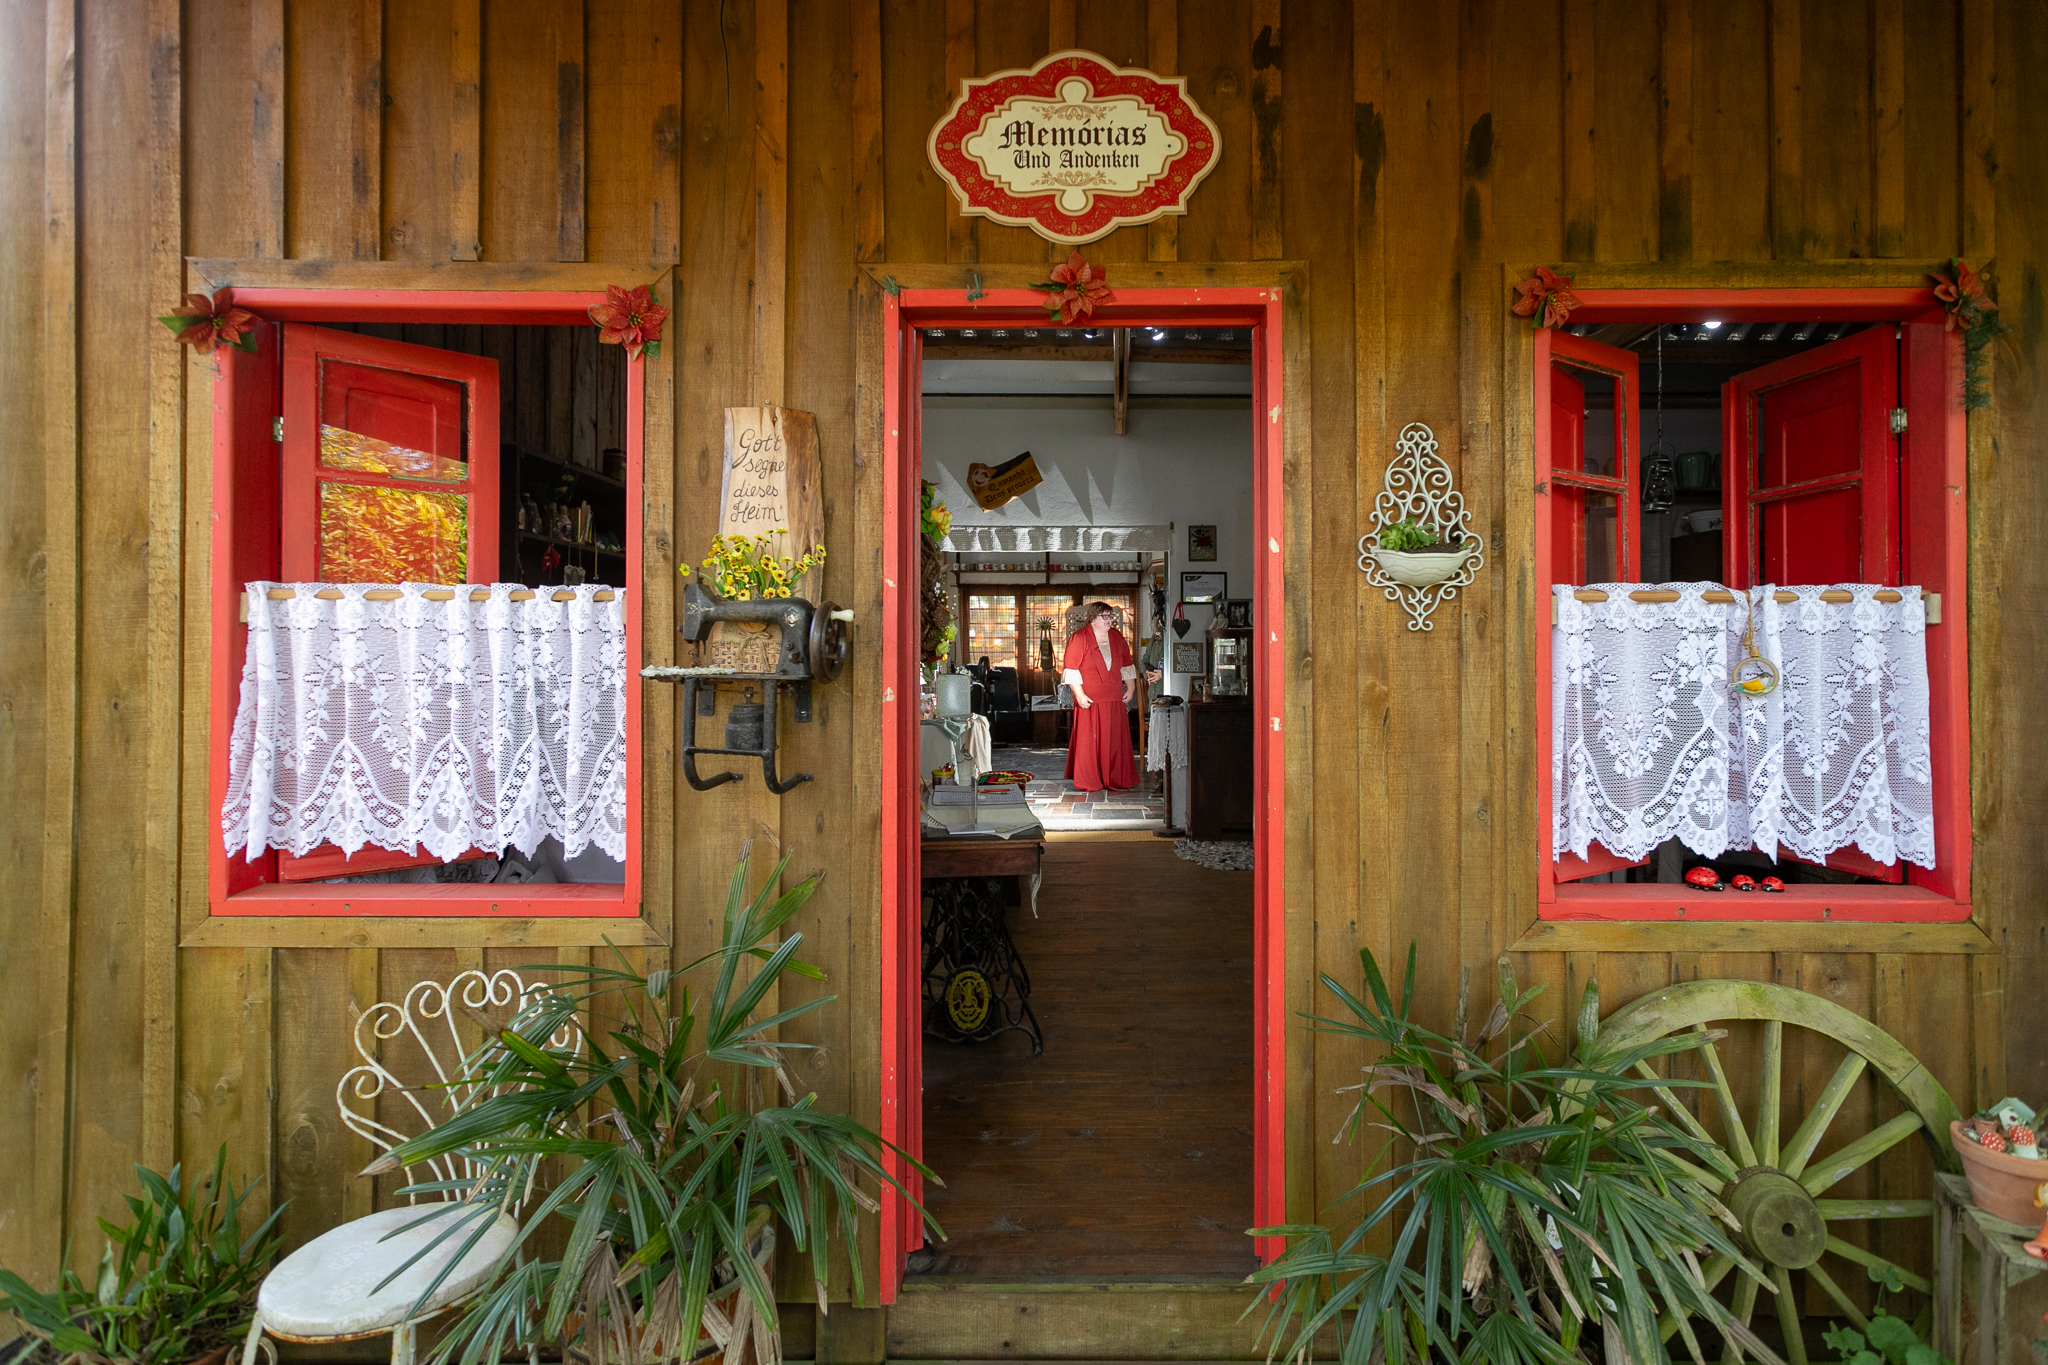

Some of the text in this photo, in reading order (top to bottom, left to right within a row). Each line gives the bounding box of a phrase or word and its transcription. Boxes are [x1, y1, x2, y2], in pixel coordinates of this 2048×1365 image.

[997, 118, 1147, 150] Memórias
[1012, 149, 1140, 169] Und Andenken
[732, 428, 782, 470] Gott
[742, 458, 787, 480] segne
[733, 479, 779, 498] dieses
[983, 490, 1006, 504] Deus
